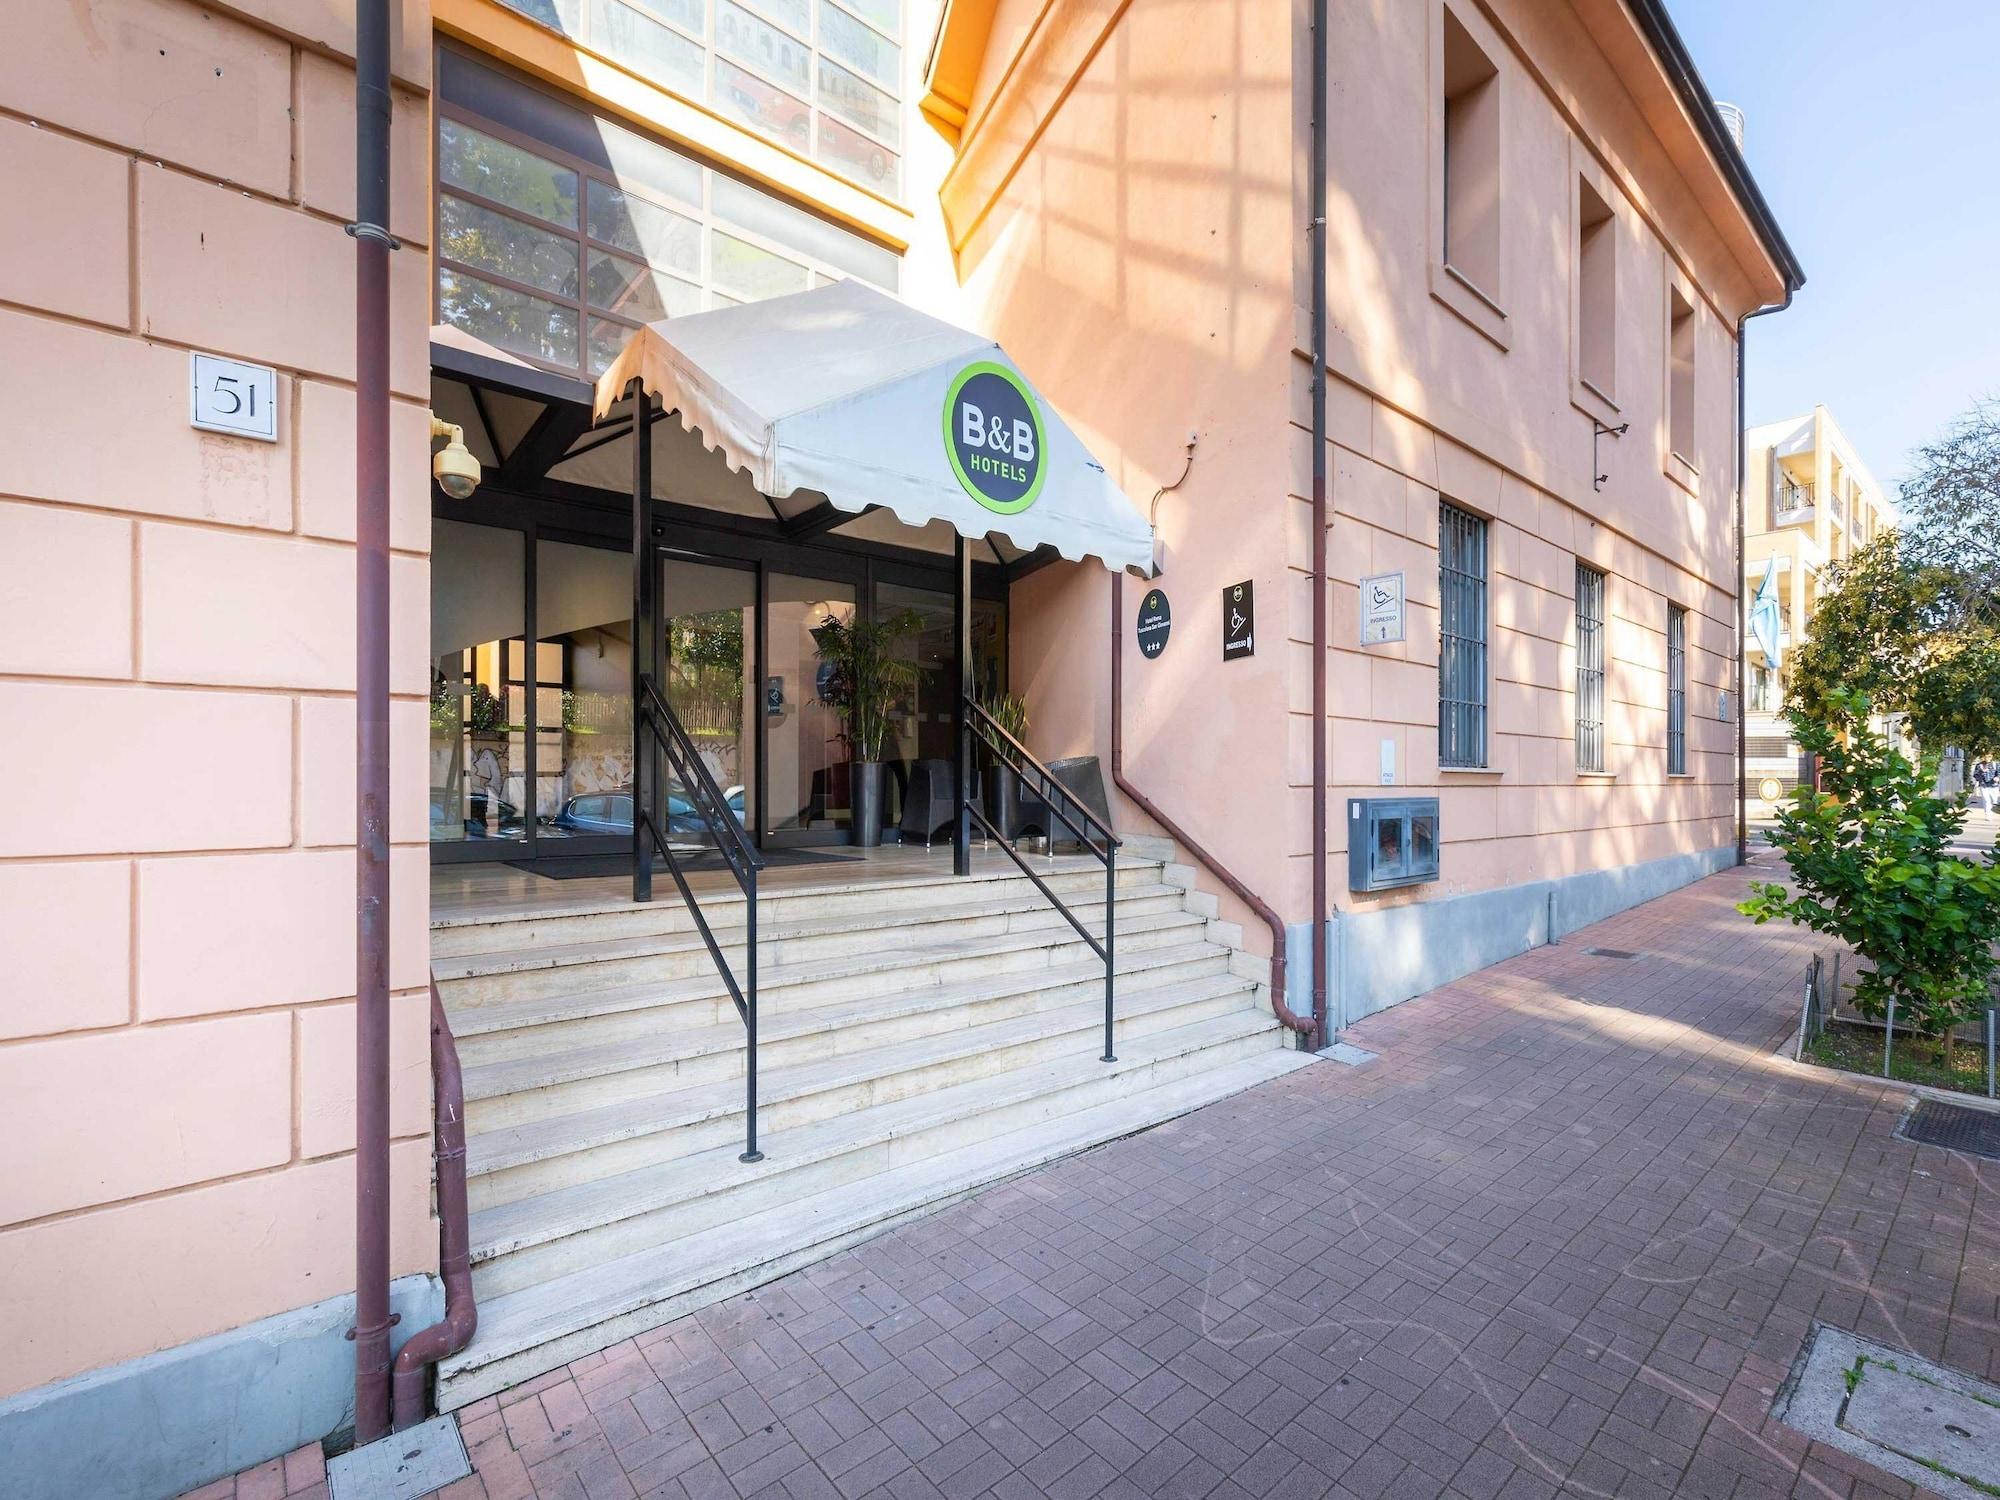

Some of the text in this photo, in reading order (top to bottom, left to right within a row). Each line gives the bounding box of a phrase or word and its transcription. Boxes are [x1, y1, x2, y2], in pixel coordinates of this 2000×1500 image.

[212, 375, 255, 417] 51
[962, 401, 1035, 462] B&B
[970, 453, 1028, 483] HOTELS
